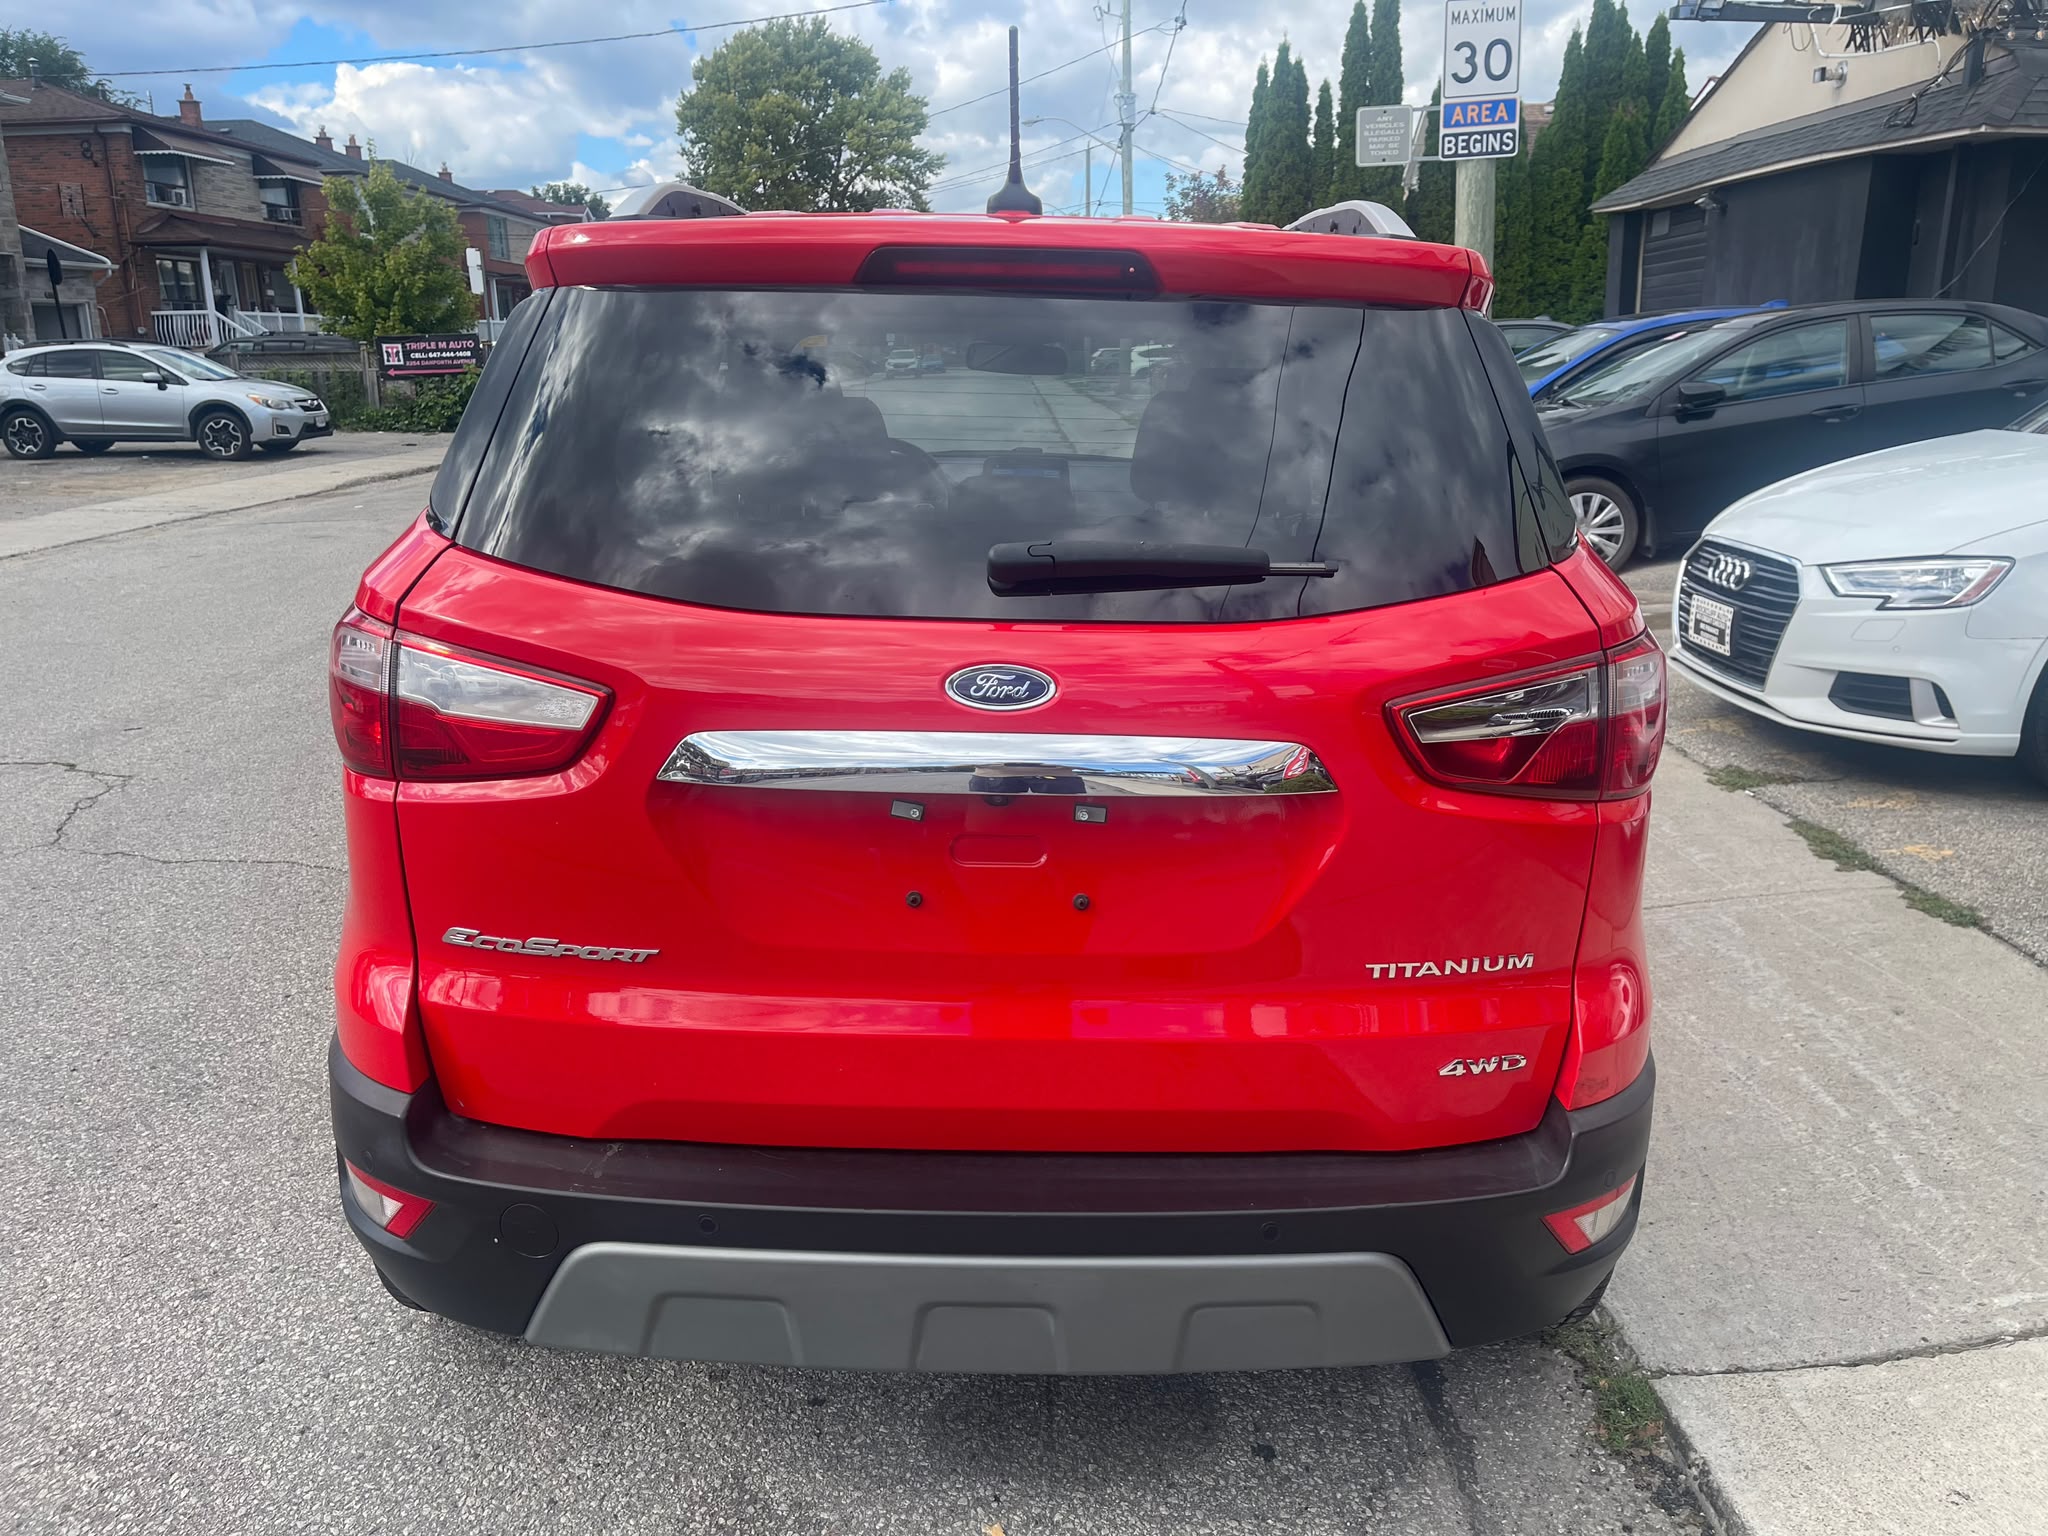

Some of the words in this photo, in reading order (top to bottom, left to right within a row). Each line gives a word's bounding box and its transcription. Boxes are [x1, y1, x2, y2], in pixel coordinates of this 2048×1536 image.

[1451, 6, 1516, 25] MAXIMUM
[1451, 38, 1513, 84] 30
[1365, 121, 1406, 129] VEHICLES
[1450, 102, 1509, 126] AREA
[1363, 128, 1405, 137] ILLEGALLY
[1443, 131, 1514, 156] BEGINS
[405, 342, 437, 350] TRIPLE
[438, 341, 446, 350] M
[449, 340, 475, 349] AUTO
[970, 673, 1031, 699] Ford
[1365, 952, 1535, 980] TITANIUM
[1437, 1053, 1528, 1077] 4WD
